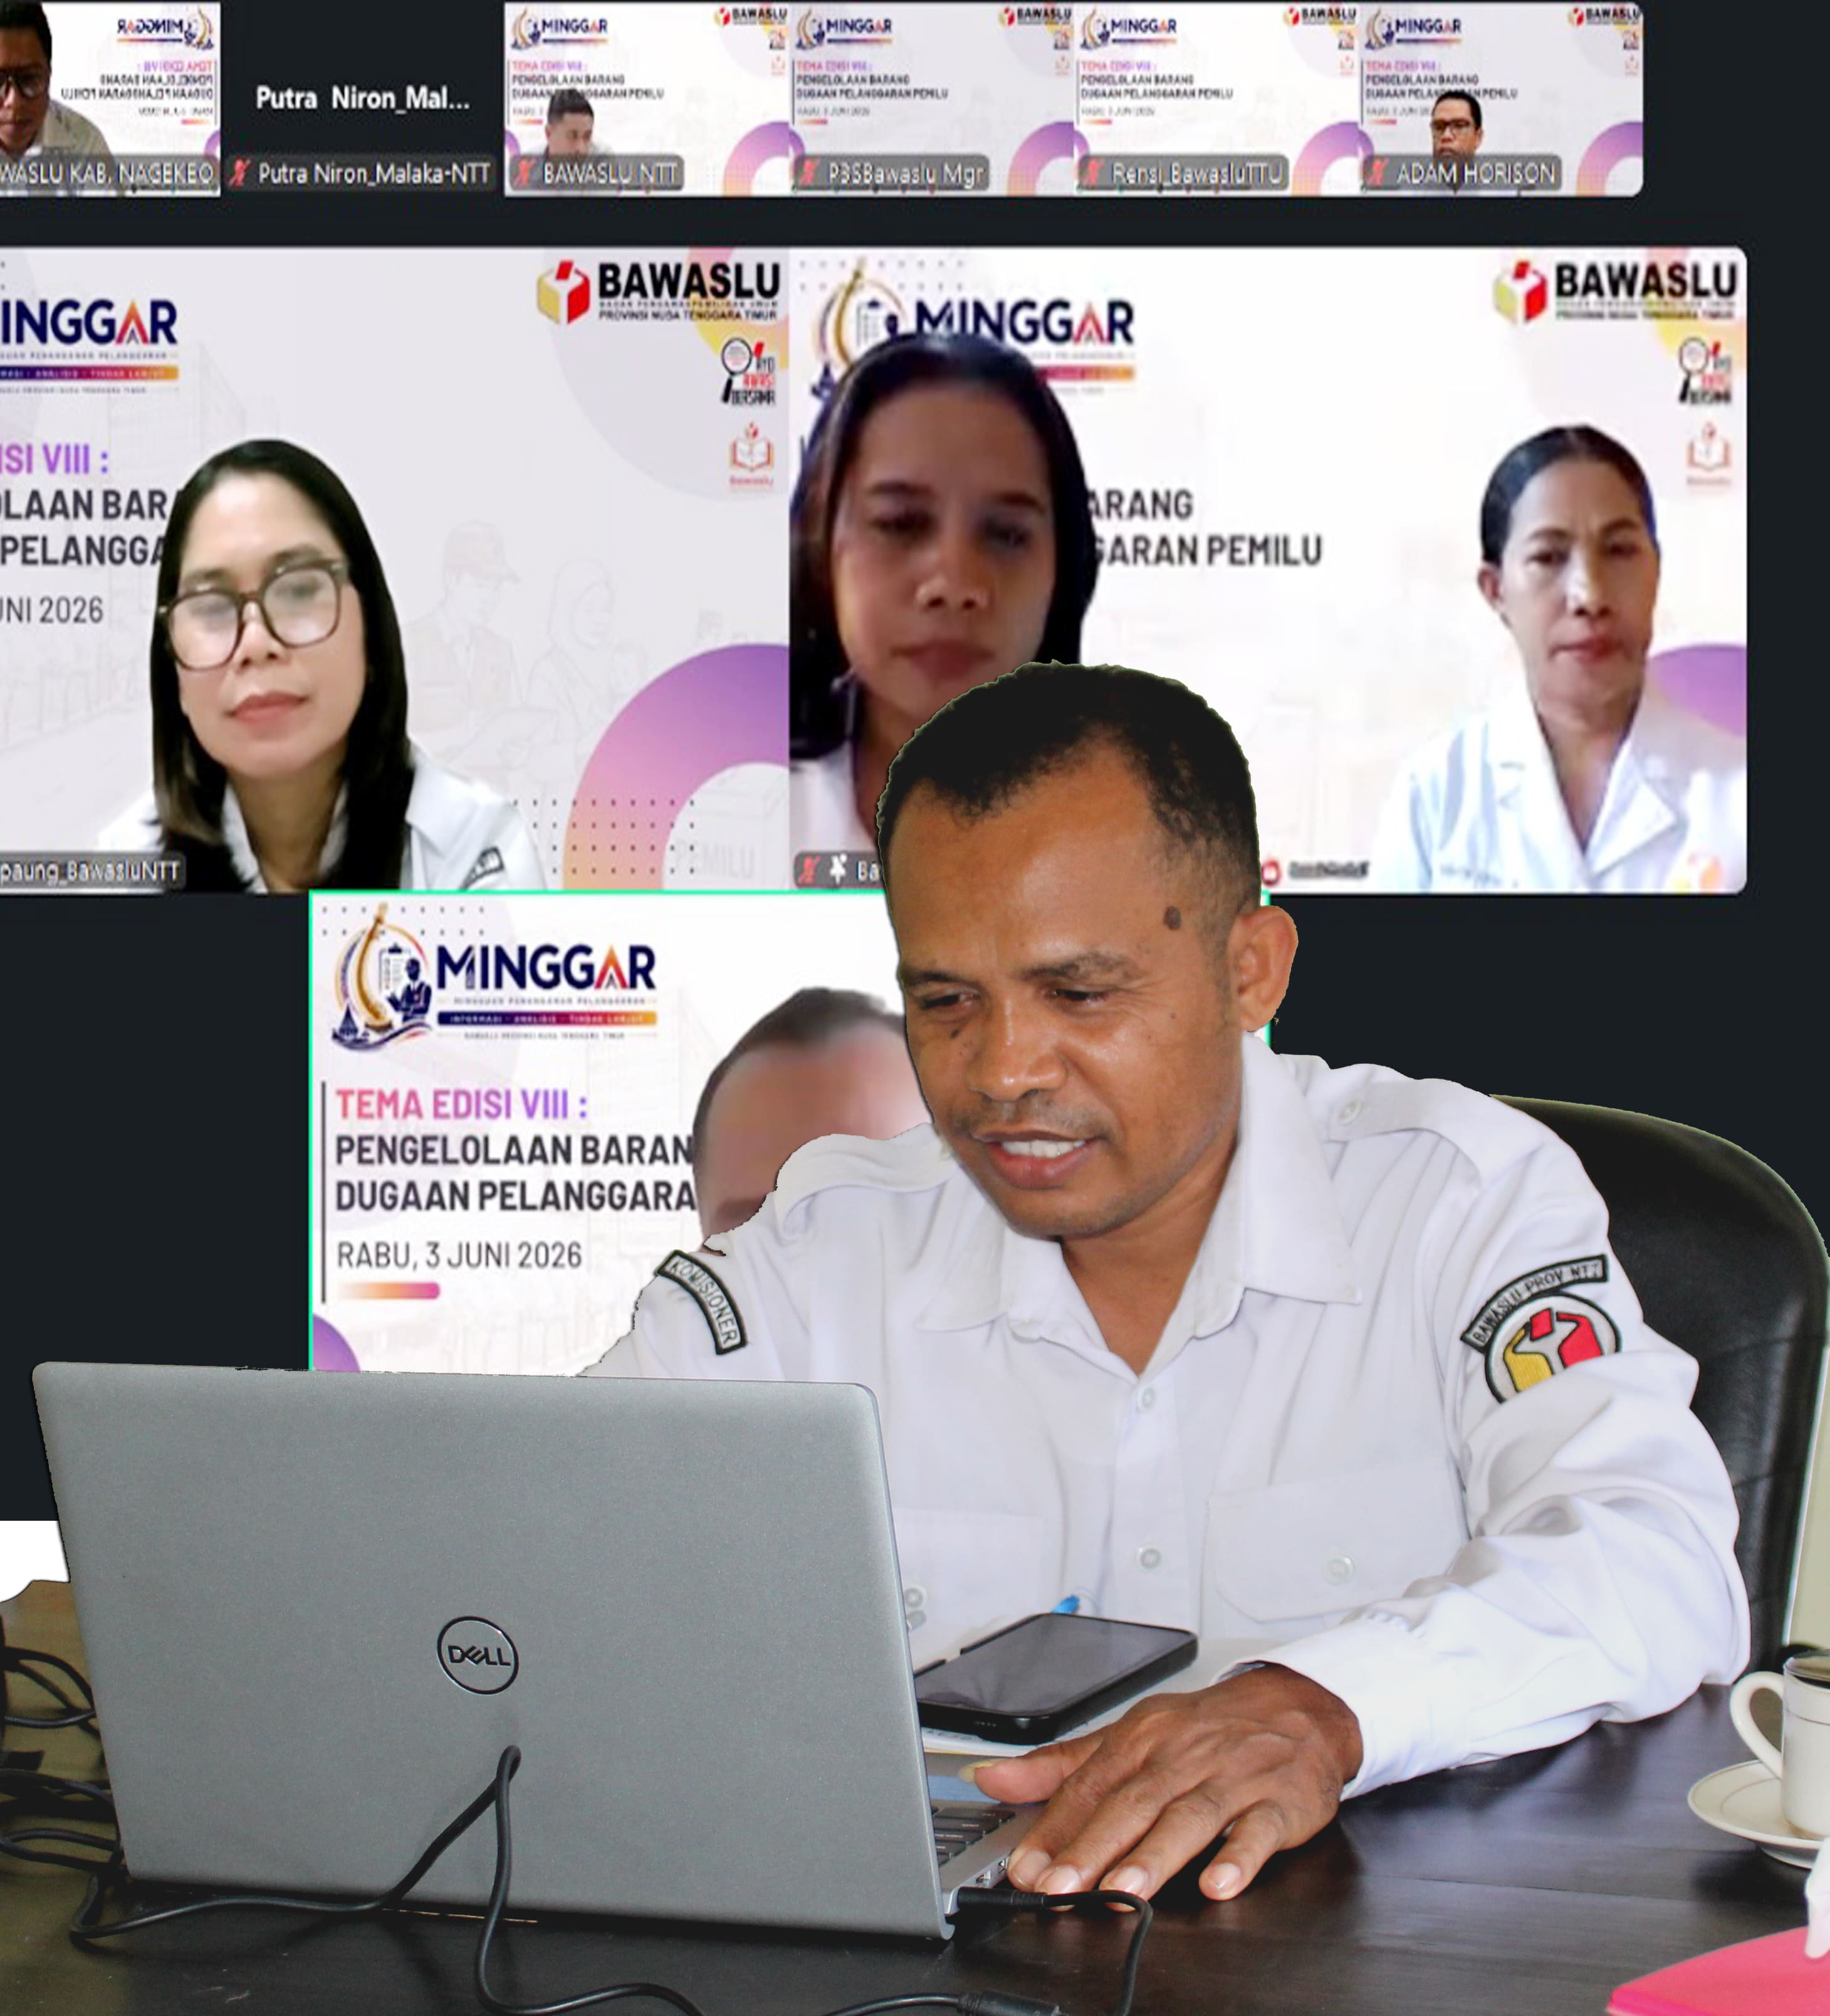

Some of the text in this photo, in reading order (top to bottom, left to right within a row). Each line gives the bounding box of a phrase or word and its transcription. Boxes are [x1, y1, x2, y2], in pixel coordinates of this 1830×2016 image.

[543, 19, 607, 33] MINGGAR
[732, 8, 787, 21] BAWASLU
[827, 19, 892, 33] MINGGAR
[1017, 8, 1072, 21] BAWASLU
[1111, 19, 1176, 33] MINGGAR
[1302, 8, 1356, 21] BAWASLU
[1396, 19, 1461, 33] MINGGAR
[1586, 8, 1641, 21] BAWASLU
[256, 85, 317, 109] Putra
[0, 163, 63, 184] WASLU
[120, 163, 214, 184] NAGEKEO
[259, 162, 491, 187] Putra Niron_Malaka-NTT
[544, 163, 677, 184] BAWASLU NTT
[943, 163, 985, 189] Mgr
[1398, 163, 1555, 184] ADAM HORISON
[599, 263, 780, 299] BAWASLU
[1555, 262, 1737, 298] BAWASLU
[1, 299, 178, 345] INGGAR
[599, 310, 777, 320] PROVINSI NUSA TENGGARA TIMUR
[916, 300, 1134, 344] MINGGAR
[43, 444, 90, 473] VIII
[0, 489, 167, 520] LAAN BAR
[1087, 488, 1193, 520] ARANG
[1, 535, 165, 565] PELANGGA
[1207, 535, 1323, 565] PEMILU
[39, 596, 103, 624] 2026
[437, 945, 656, 990] MINGGAR
[336, 1089, 424, 1120] TEMA
[433, 1089, 512, 1120] EDISI
[521, 1089, 568, 1120] VIII
[337, 1135, 693, 1165] PENGELOLAAN BARAN
[337, 1180, 697, 1211] DUGAAN PELANGGARA
[338, 1242, 582, 1272] RABU, 3 JUNI 2026
[669, 1258, 738, 1345] KOMISIONER
[1472, 1288, 1522, 1343] BAWASLU
[1524, 1268, 1564, 1292] PROV
[448, 1645, 511, 1666] DELL
